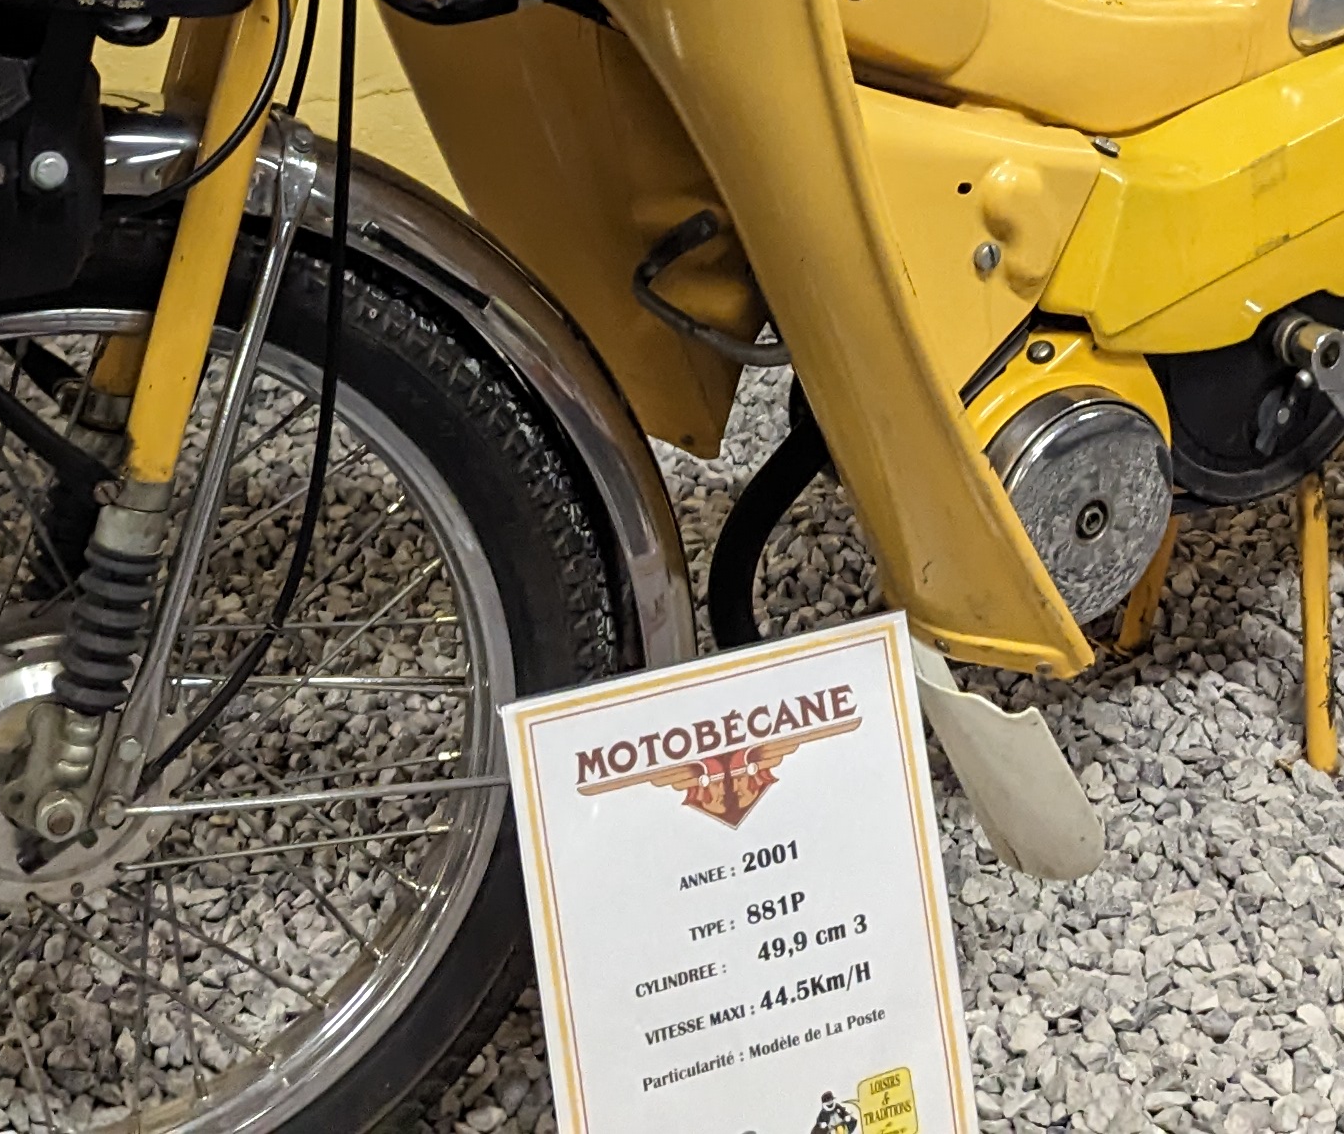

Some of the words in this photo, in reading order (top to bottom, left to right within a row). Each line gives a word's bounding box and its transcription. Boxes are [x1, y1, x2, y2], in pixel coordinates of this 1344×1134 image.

[576, 684, 858, 785] MOTOBÉCANE
[742, 840, 798, 873] 2001
[689, 919, 725, 941] TYPE
[746, 891, 805, 925] 881P
[757, 931, 808, 961] 49,9
[815, 924, 846, 946] cm
[853, 914, 868, 934] 3
[644, 1016, 704, 1045] VITESSE
[709, 1004, 746, 1026] MAXI
[760, 961, 871, 1010] 44.5Km/H
[642, 1054, 734, 1092] Particularité
[748, 1035, 800, 1058] Modèle
[804, 1028, 821, 1043] de
[825, 1022, 843, 1036] La
[846, 1010, 885, 1030] Poste
[864, 1100, 912, 1125] TRADITIONS
